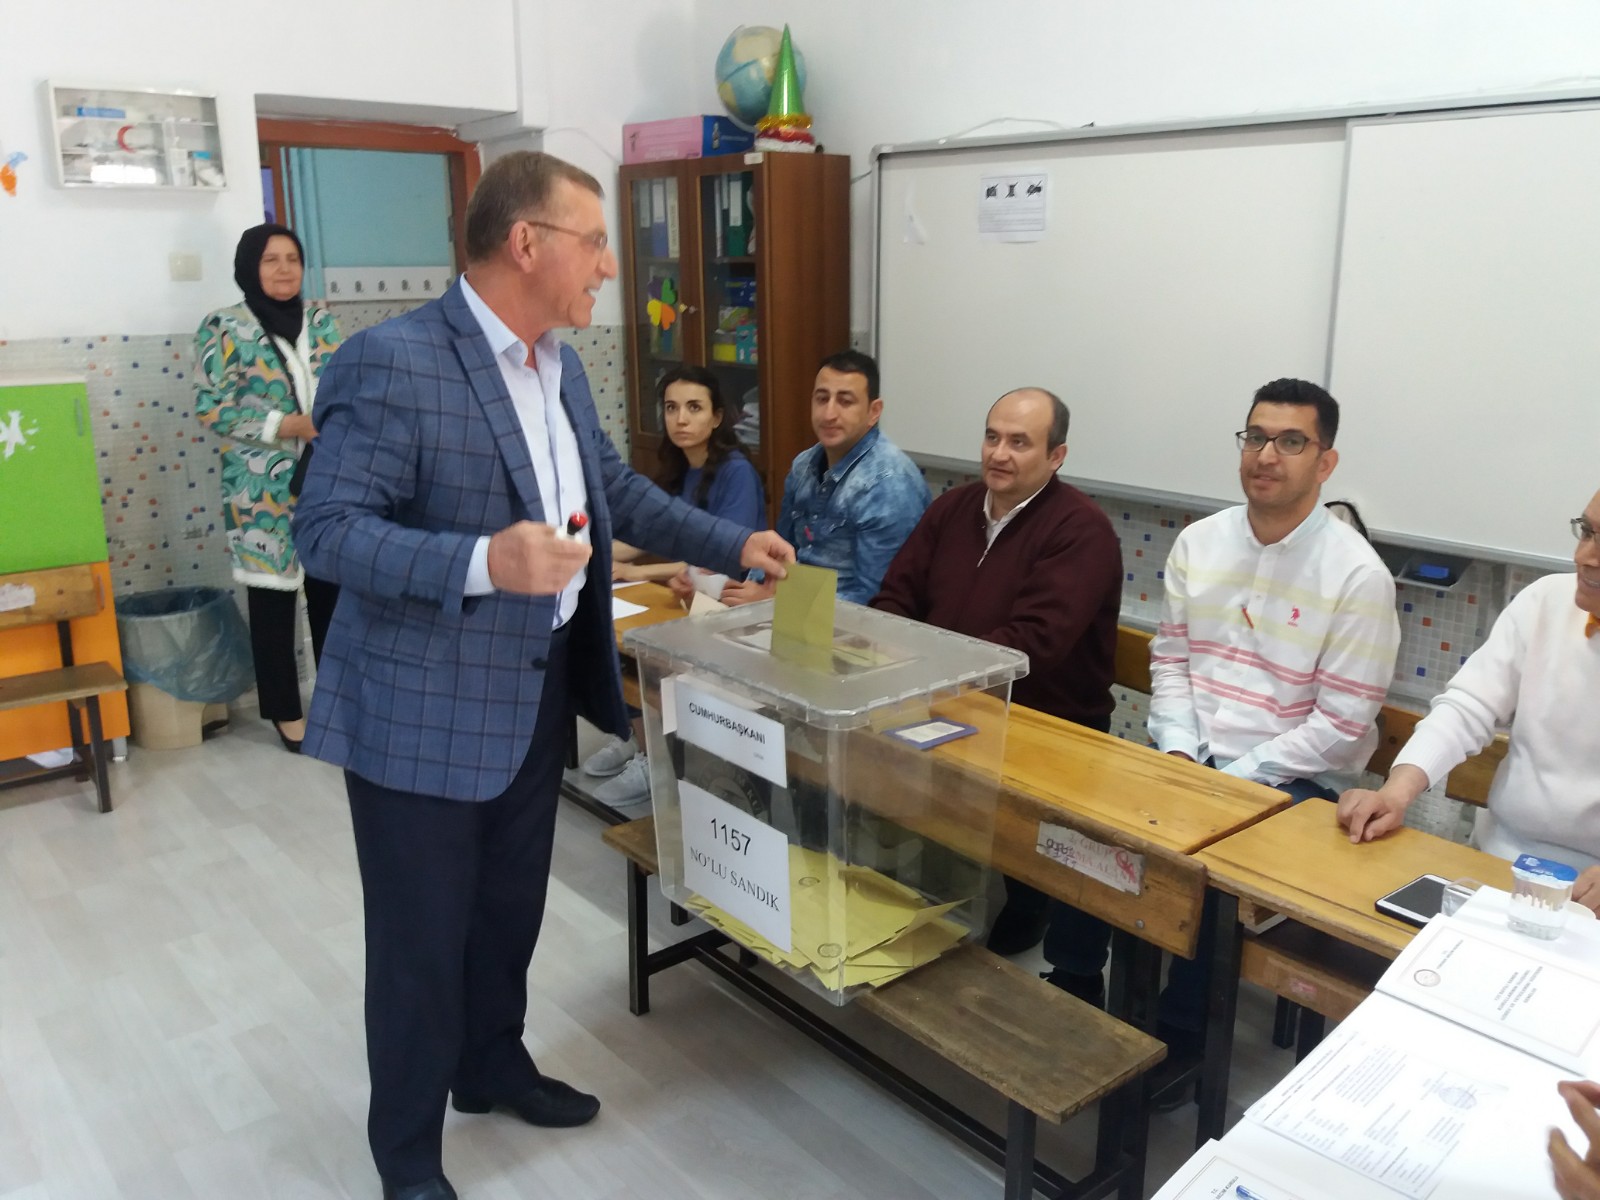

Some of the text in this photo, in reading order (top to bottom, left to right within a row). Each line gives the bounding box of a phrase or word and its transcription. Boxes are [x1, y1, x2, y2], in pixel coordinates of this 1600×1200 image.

[689, 702, 766, 744] CUMHURBAŞKANI
[711, 818, 751, 856] 1157
[730, 870, 780, 912] SANDIK
